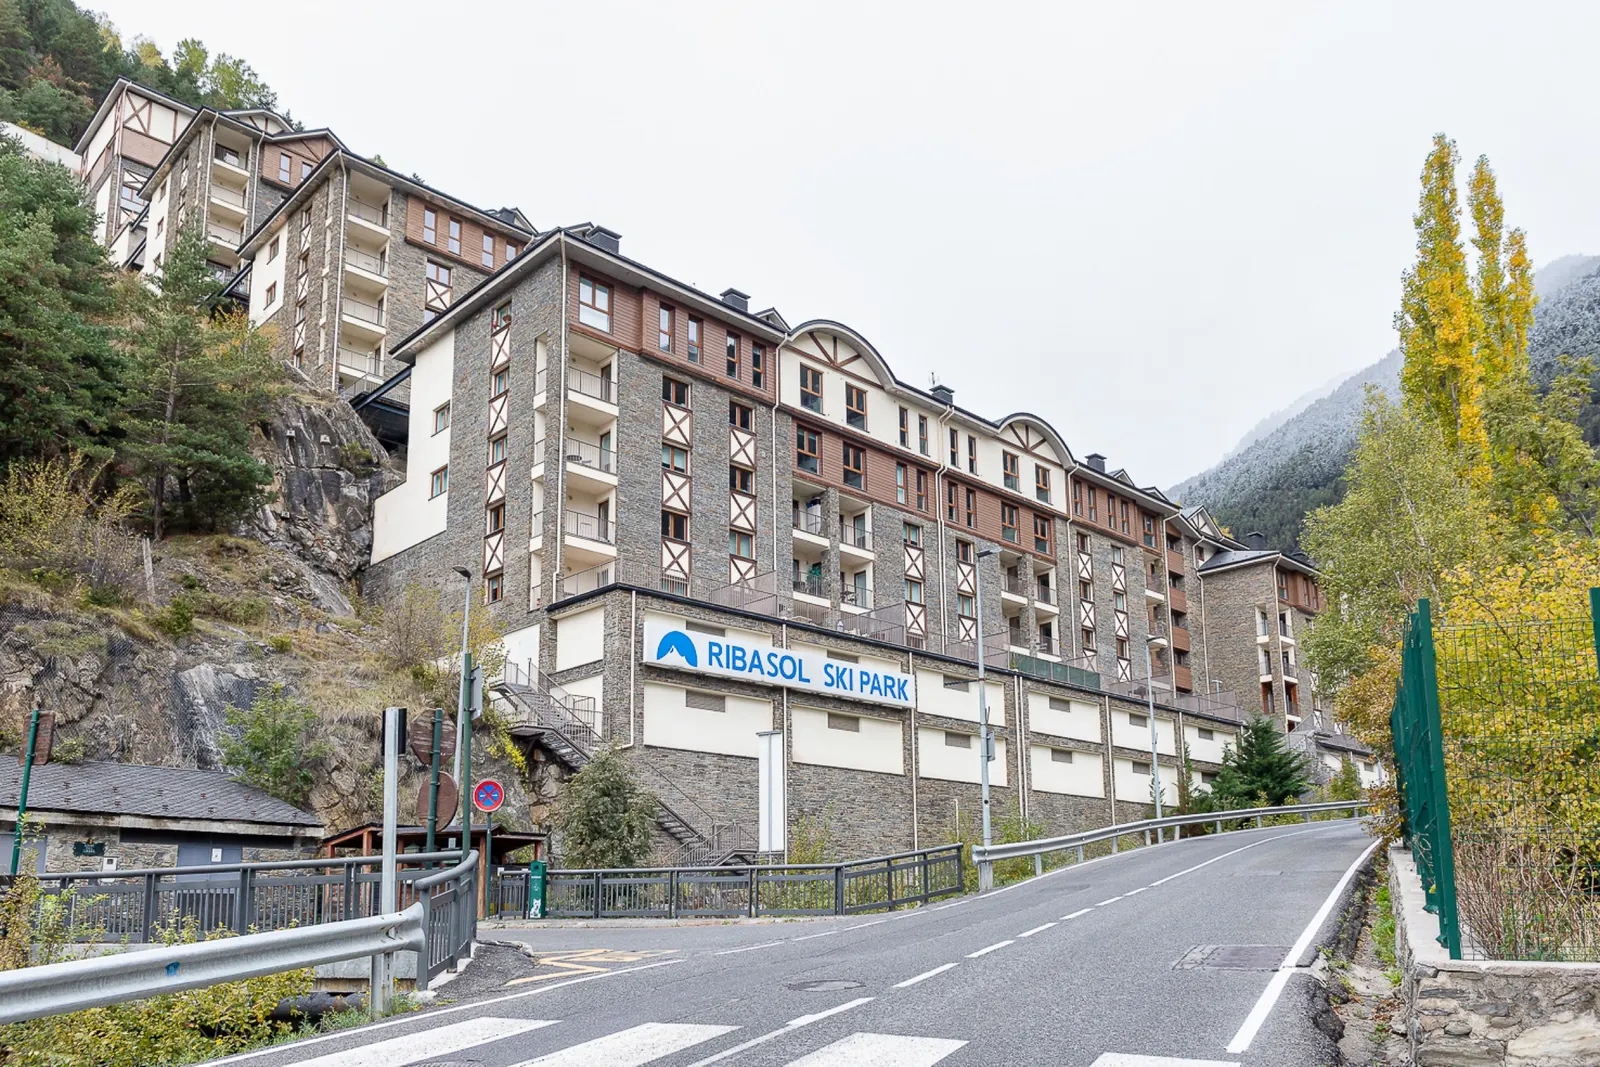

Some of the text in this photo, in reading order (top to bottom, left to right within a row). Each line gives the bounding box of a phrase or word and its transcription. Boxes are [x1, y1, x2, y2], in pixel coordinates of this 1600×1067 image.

[708, 641, 909, 701] RIBASOL SKI PARK
